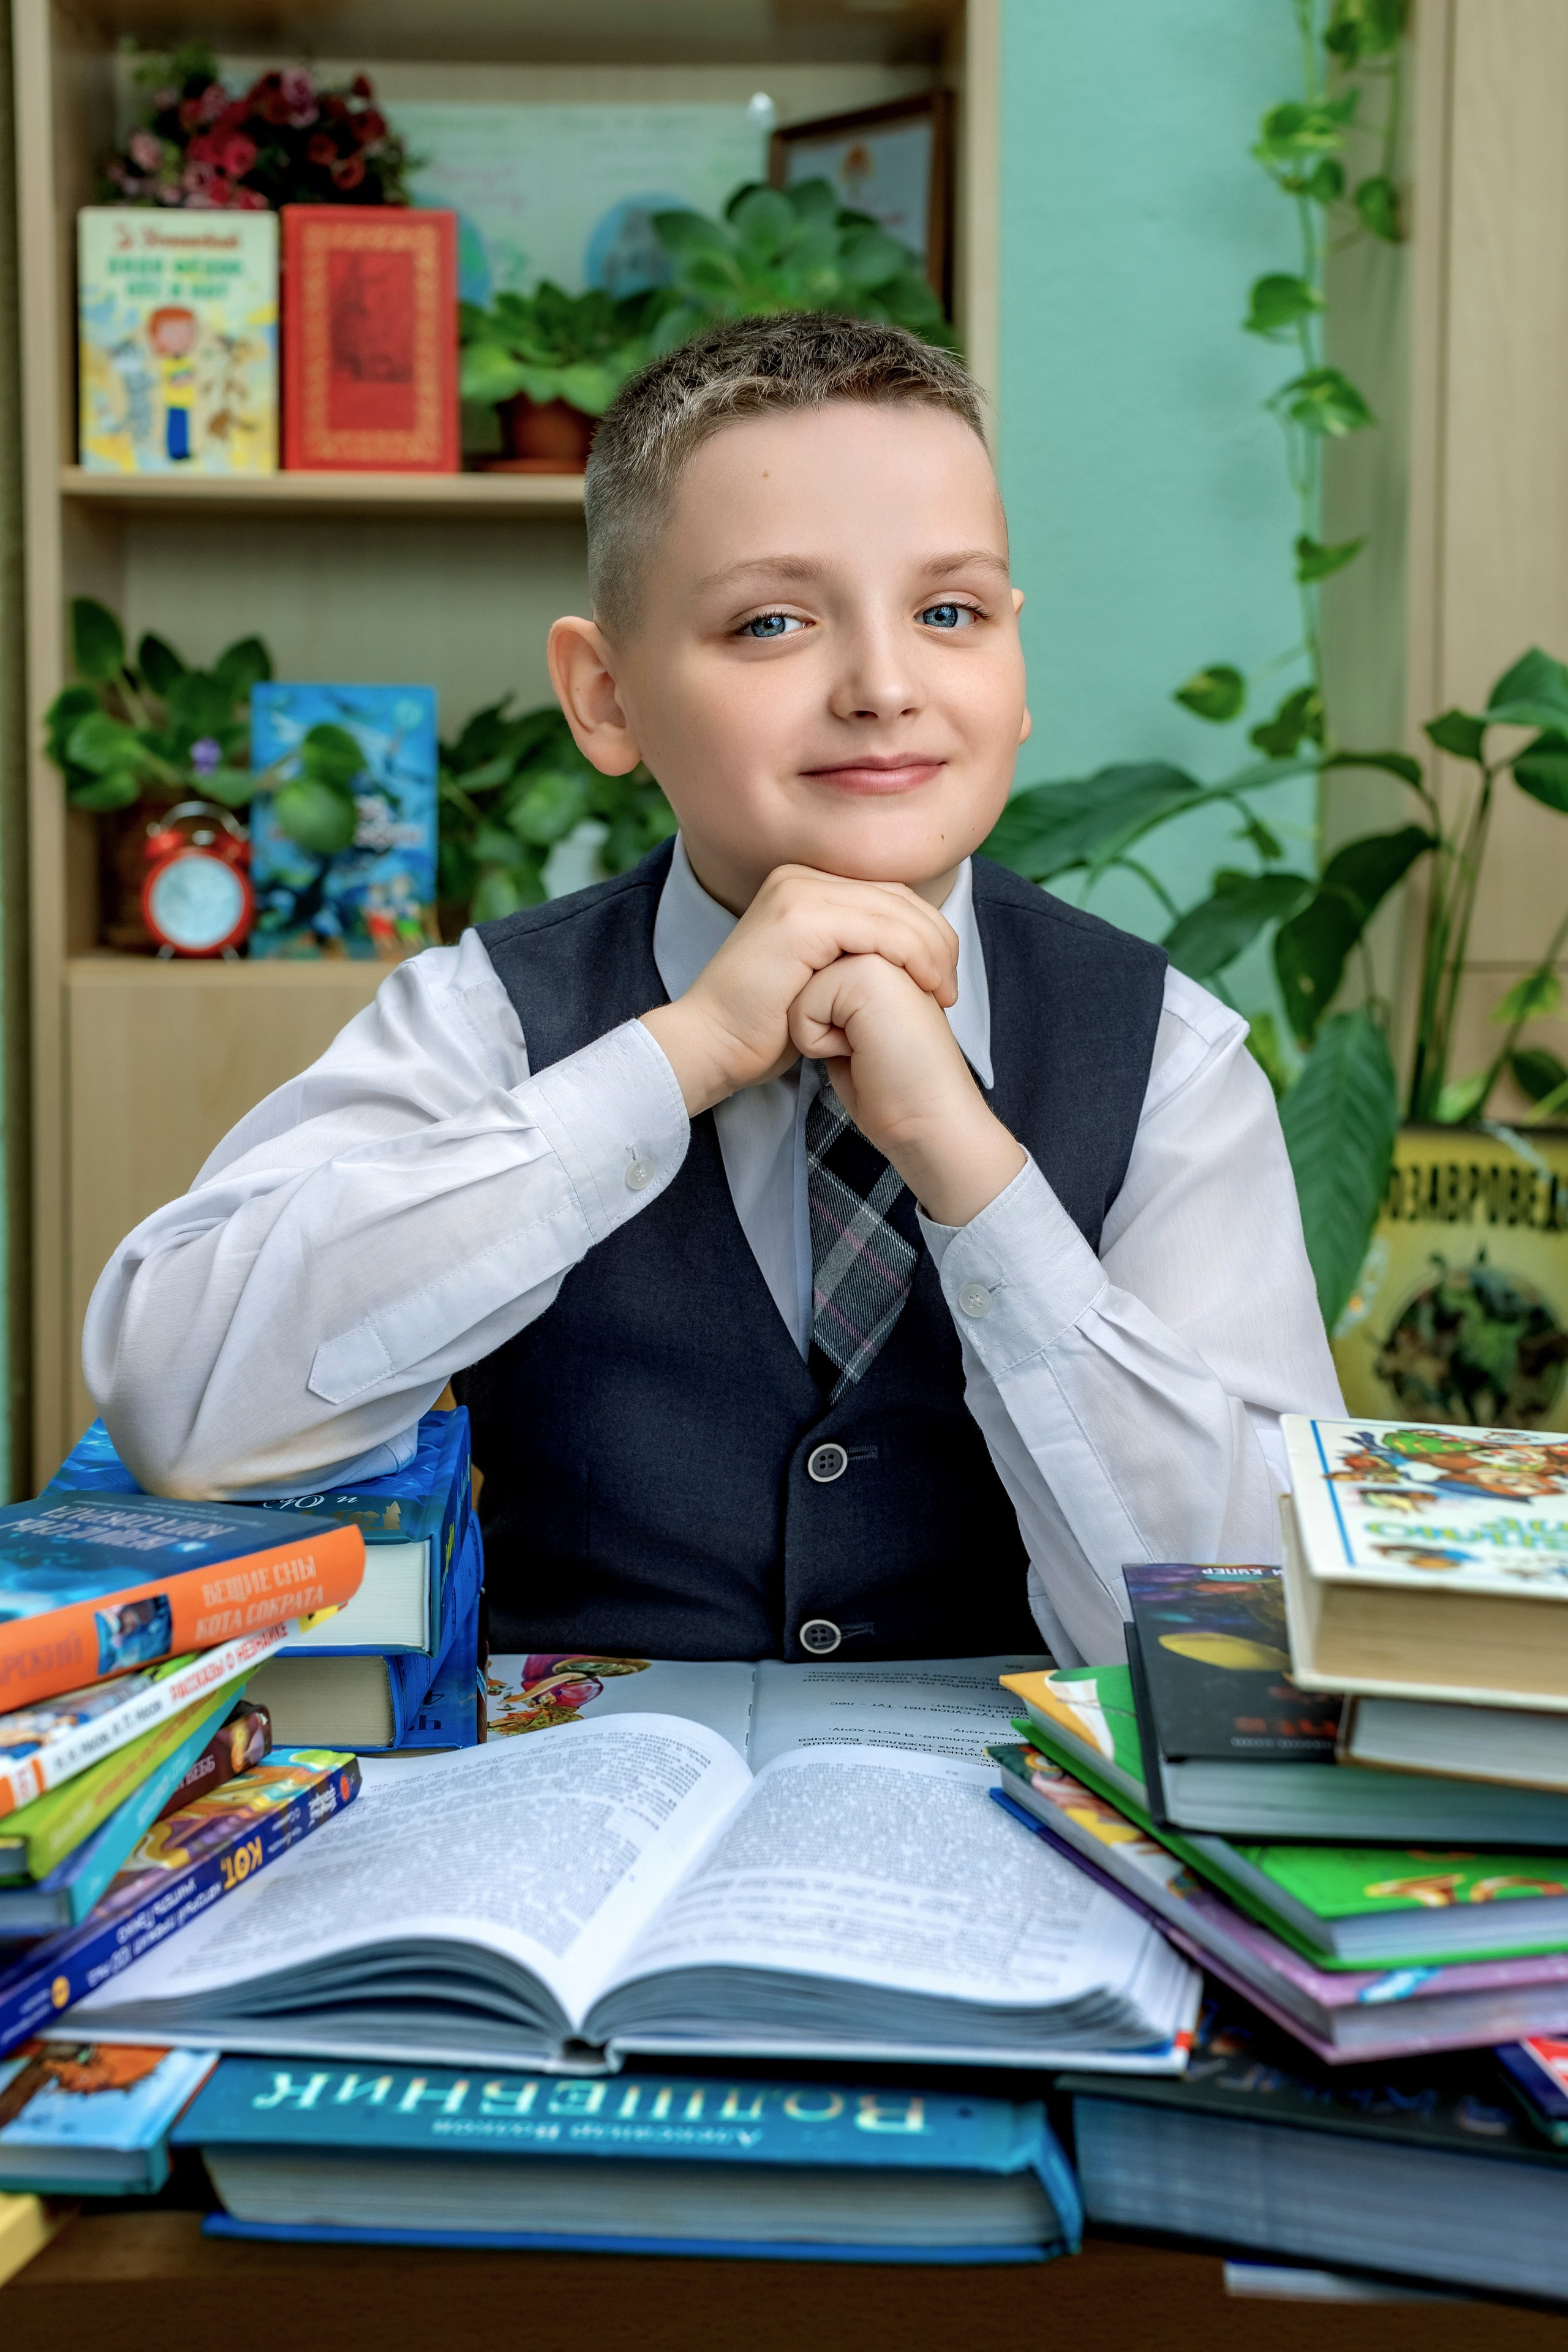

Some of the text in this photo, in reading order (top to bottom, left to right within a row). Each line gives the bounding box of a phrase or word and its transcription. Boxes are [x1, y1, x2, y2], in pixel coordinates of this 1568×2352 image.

[203, 1555, 317, 1608] ВЕЩИЕ СНЫ
[1201, 1567, 1263, 1576] КУПЕР
[195, 1585, 324, 1642] КОТА СОКРАТА
[919, 1734, 979, 1744] больше.
[252, 2071, 933, 2137] ВОЛШЕБНИК
